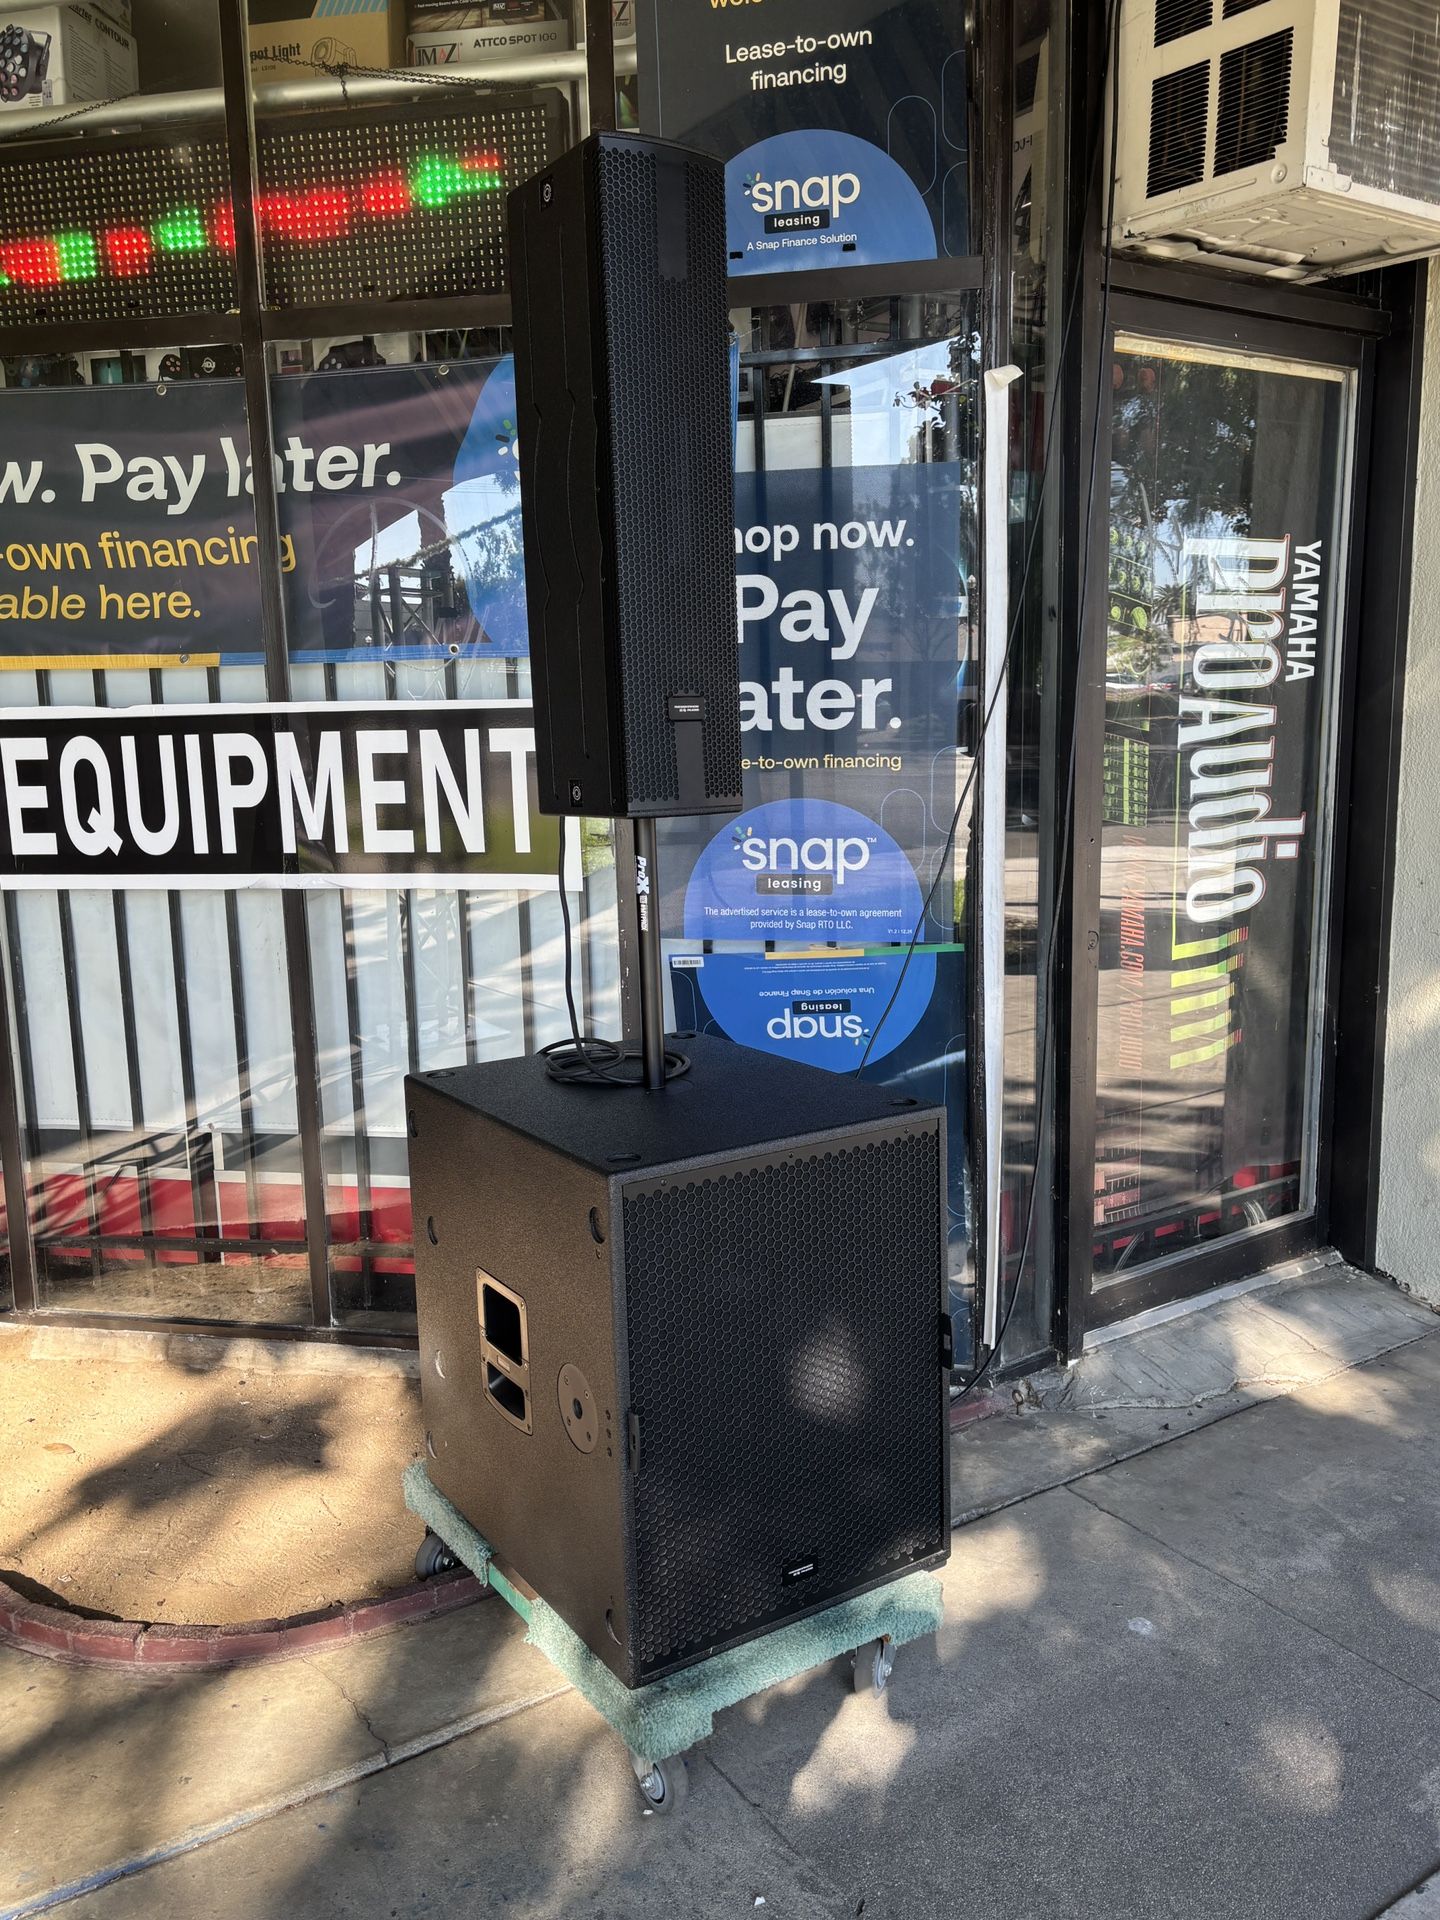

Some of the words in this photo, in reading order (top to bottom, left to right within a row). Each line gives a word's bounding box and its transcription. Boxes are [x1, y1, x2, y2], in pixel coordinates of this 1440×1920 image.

[95, 18, 130, 50] CONTOUR
[474, 37, 507, 48] ATTCO
[509, 34, 537, 45] SPOT
[539, 32, 557, 42] 100
[725, 27, 873, 65] Lease-to-own
[273, 43, 301, 61] Light
[750, 61, 847, 91] financing
[752, 172, 861, 218] snap
[774, 214, 820, 228] leasing
[747, 242, 754, 251] A
[756, 240, 779, 250] Snap
[782, 236, 818, 248] Finance
[819, 233, 857, 244] Solution
[75, 442, 206, 515] Pay
[813, 519, 915, 550] now.
[98, 583, 201, 621] here.
[1285, 540, 1322, 682] YAMAHA
[735, 574, 880, 661] Pay
[1177, 533, 1307, 924] ProAudio
[823, 753, 902, 771] financing
[0, 727, 536, 857] EQUIPMENT
[742, 837, 870, 884] snap
[768, 877, 822, 893] leasing
[704, 906, 718, 916] The
[720, 906, 759, 917] advertised
[761, 907, 788, 917] service
[790, 908, 797, 917] is
[799, 909, 804, 917] a
[806, 908, 857, 918] lease-to-own
[859, 909, 902, 919] agreement
[750, 919, 783, 930] provided
[785, 919, 794, 930] by
[796, 919, 816, 930] Snap
[818, 920, 834, 929] RTO
[836, 921, 853, 930] LLC.
[759, 989, 789, 998] Finance
[791, 988, 811, 997] Snap
[812, 988, 823, 996] de
[824, 987, 857, 996] solución
[801, 1003, 843, 1012] leasing
[766, 1008, 863, 1040] snap
